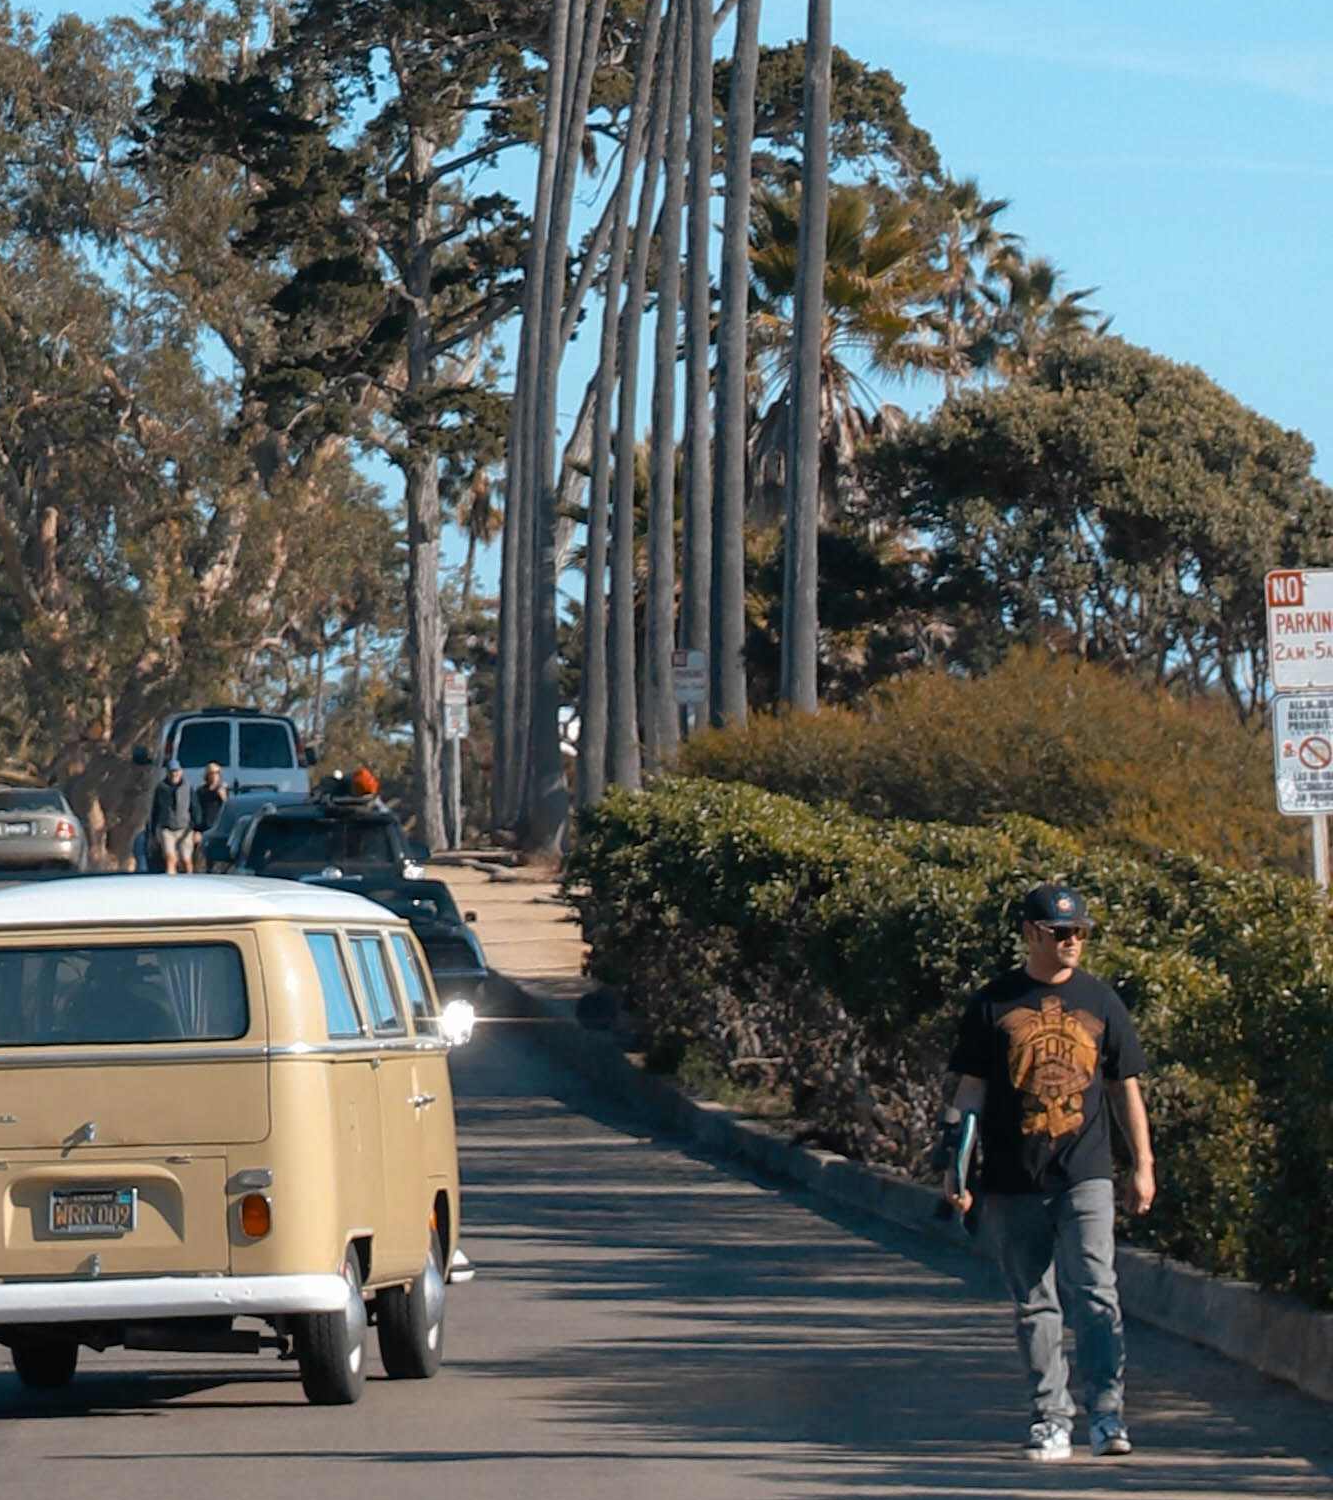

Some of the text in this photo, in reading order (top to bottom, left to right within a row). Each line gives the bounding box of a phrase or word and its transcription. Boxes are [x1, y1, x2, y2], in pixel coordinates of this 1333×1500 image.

[1272, 575, 1300, 604] NO
[1276, 610, 1333, 635] PARKIN
[1031, 1035, 1074, 1064] FOX
